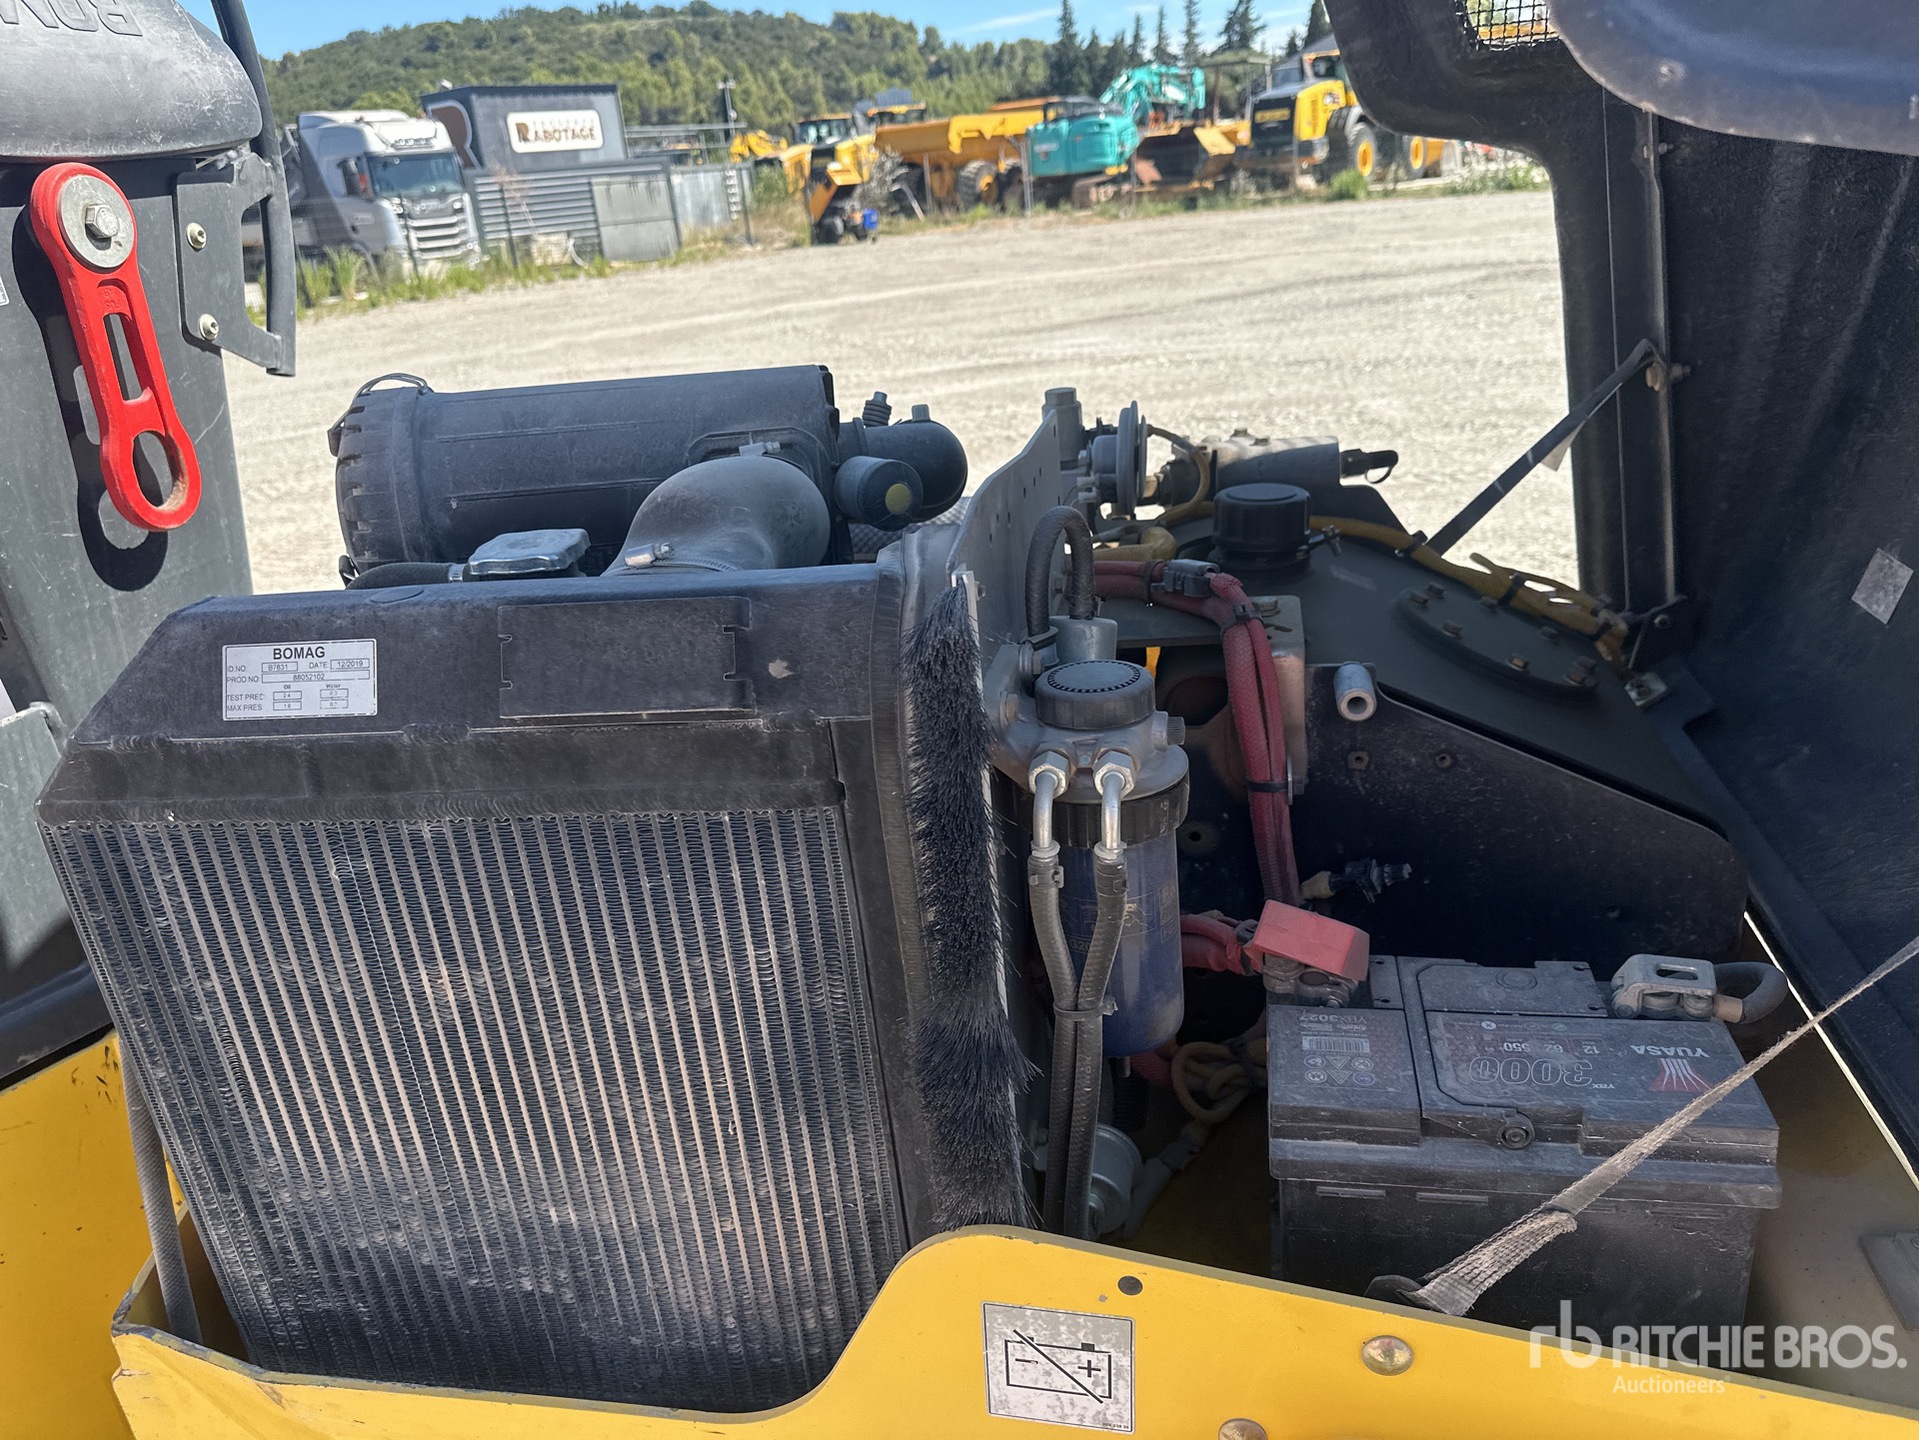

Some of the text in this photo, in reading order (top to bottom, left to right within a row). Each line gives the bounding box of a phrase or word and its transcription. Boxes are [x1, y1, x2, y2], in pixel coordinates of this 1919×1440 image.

[515, 122, 598, 143] RABOTAGE
[273, 646, 326, 660] BOMAG
[337, 660, 364, 668] 12/2019
[226, 693, 243, 702] TEST
[1299, 1010, 1368, 1024] YBX3027
[1503, 1042, 1531, 1052] 550
[1543, 1043, 1564, 1053] 62
[1582, 1045, 1600, 1054] 12
[1629, 1044, 1711, 1058] YUASA
[1469, 1056, 1593, 1087] 3000
